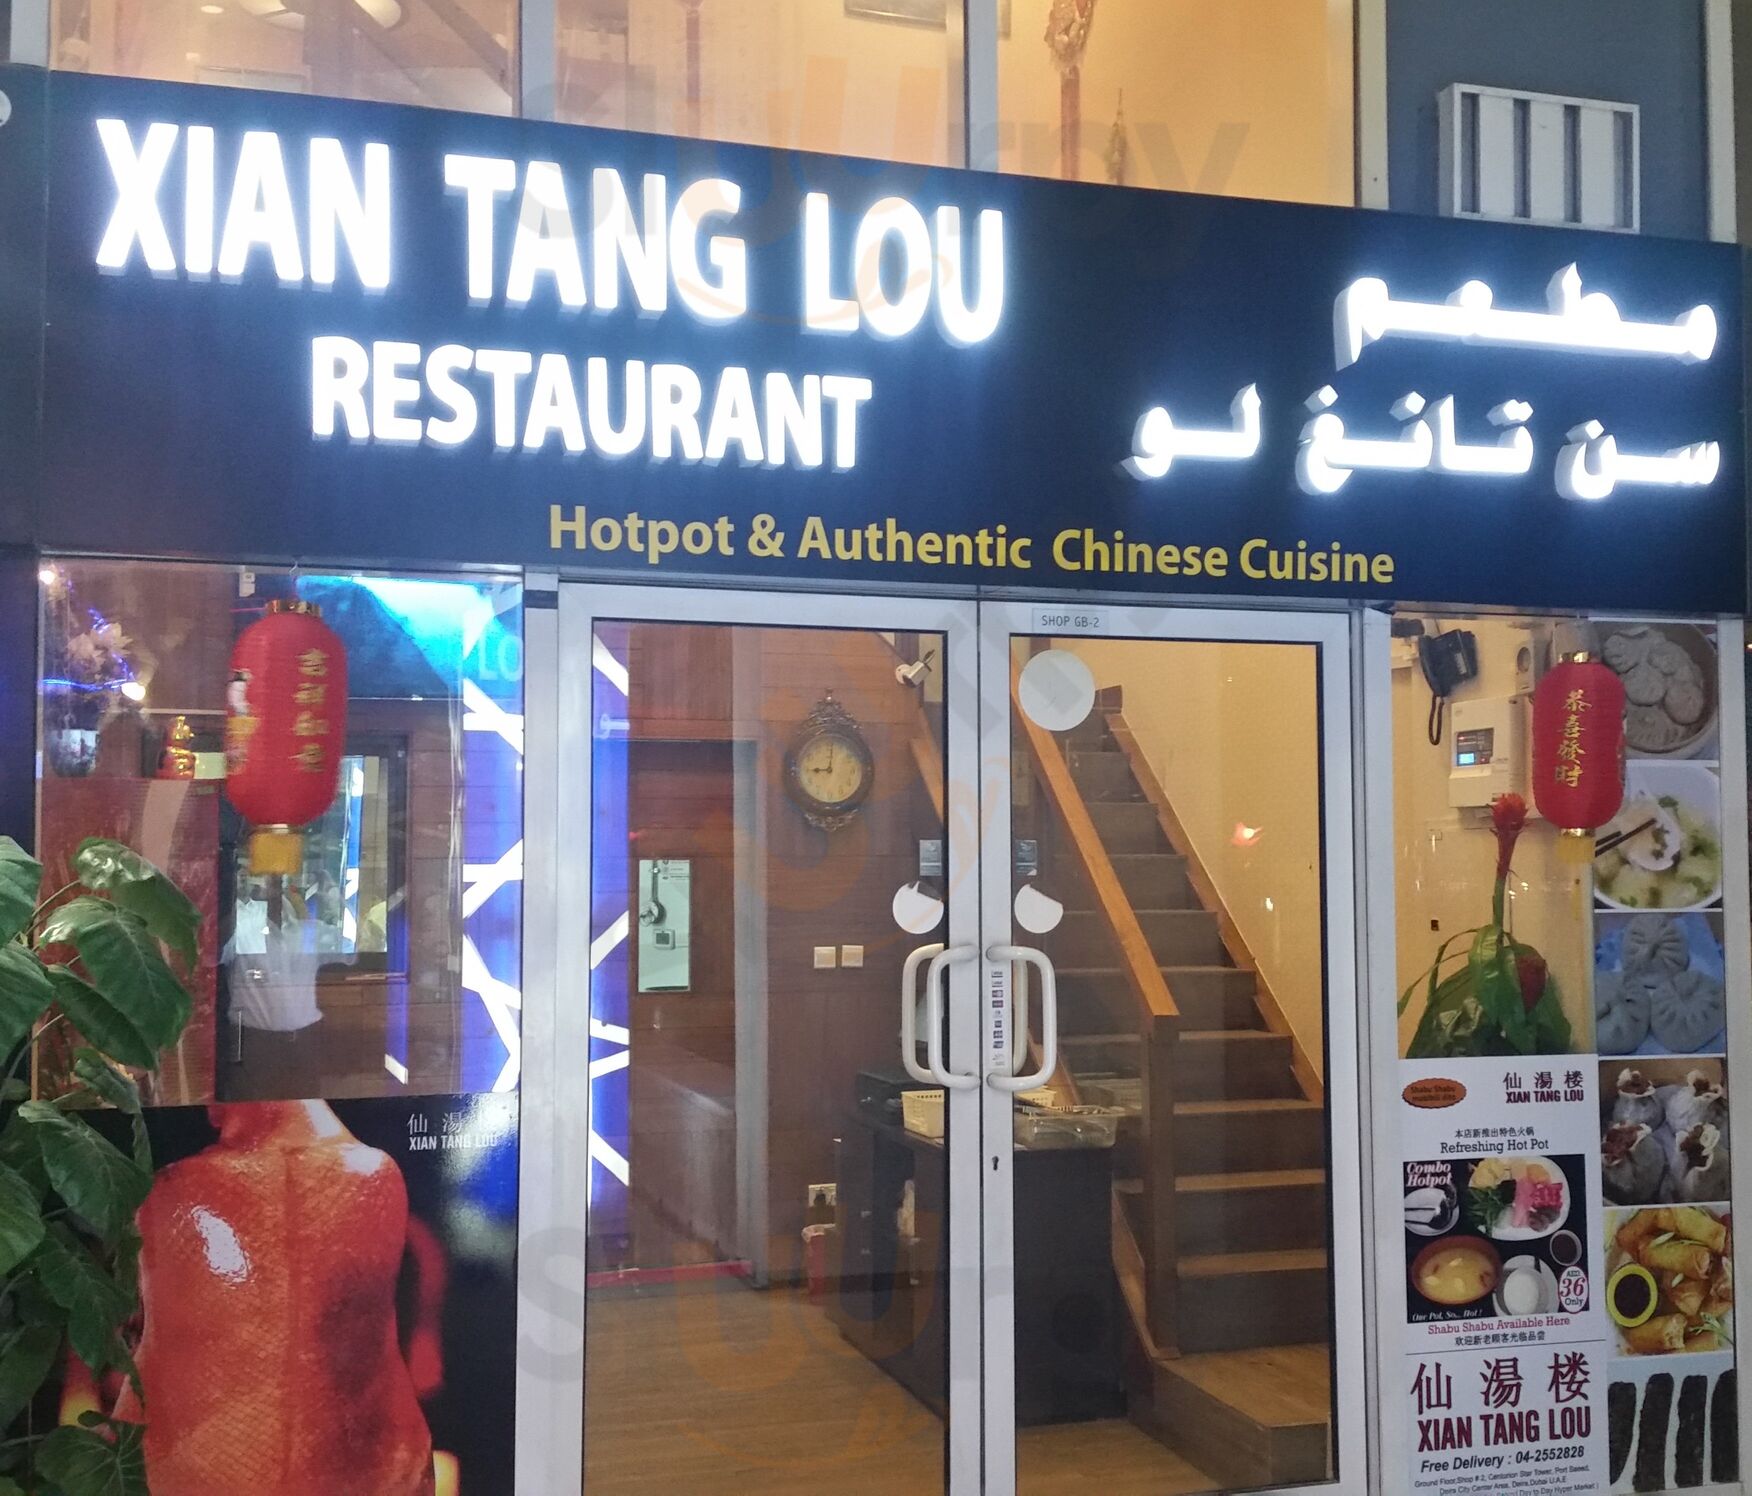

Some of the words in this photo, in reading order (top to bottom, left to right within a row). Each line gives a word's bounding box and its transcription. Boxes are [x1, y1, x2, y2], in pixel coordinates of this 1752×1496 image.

[95, 118, 392, 289] XIAN
[443, 153, 746, 319] TANG
[803, 192, 1005, 346] LOU
[1333, 262, 1718, 370] مطعم
[311, 336, 872, 469] RESTAURANT
[1121, 382, 1262, 480] لو
[1296, 384, 1535, 495] تانغ
[1555, 419, 1720, 501] سن
[549, 504, 734, 564] Hotpot
[748, 513, 785, 558] &
[798, 516, 1032, 570] Authentic
[1052, 528, 1228, 577] Chinese
[1239, 537, 1395, 585] Cuisine
[1041, 615, 1071, 627] SHOP
[1074, 616, 1100, 628] GB-2
[1506, 1091, 1530, 1104] XIAN
[1533, 1090, 1560, 1103] TANG
[1564, 1089, 1584, 1102] LOU
[409, 1136, 437, 1150] XIAN
[441, 1134, 472, 1149] TANG
[1440, 1140, 1504, 1155] Refreshing
[1507, 1139, 1528, 1151] Hot
[1530, 1138, 1549, 1150] Pot
[1406, 1161, 1451, 1175] Combo
[1406, 1172, 1453, 1188] Hotpot
[1560, 1276, 1586, 1297] 36
[1564, 1297, 1584, 1307] Only
[1428, 1324, 1460, 1335] Shabu
[1463, 1321, 1494, 1333] Shabu
[1496, 1317, 1542, 1330] Available
[1545, 1316, 1571, 1327] Here
[1417, 1415, 1472, 1452] XIAN
[1480, 1409, 1540, 1446] TANG
[1548, 1406, 1592, 1441] LOU
[1420, 1459, 1449, 1473] Free
[1453, 1454, 1504, 1471] Delivery
[1515, 1446, 1585, 1465] 04-2552828
